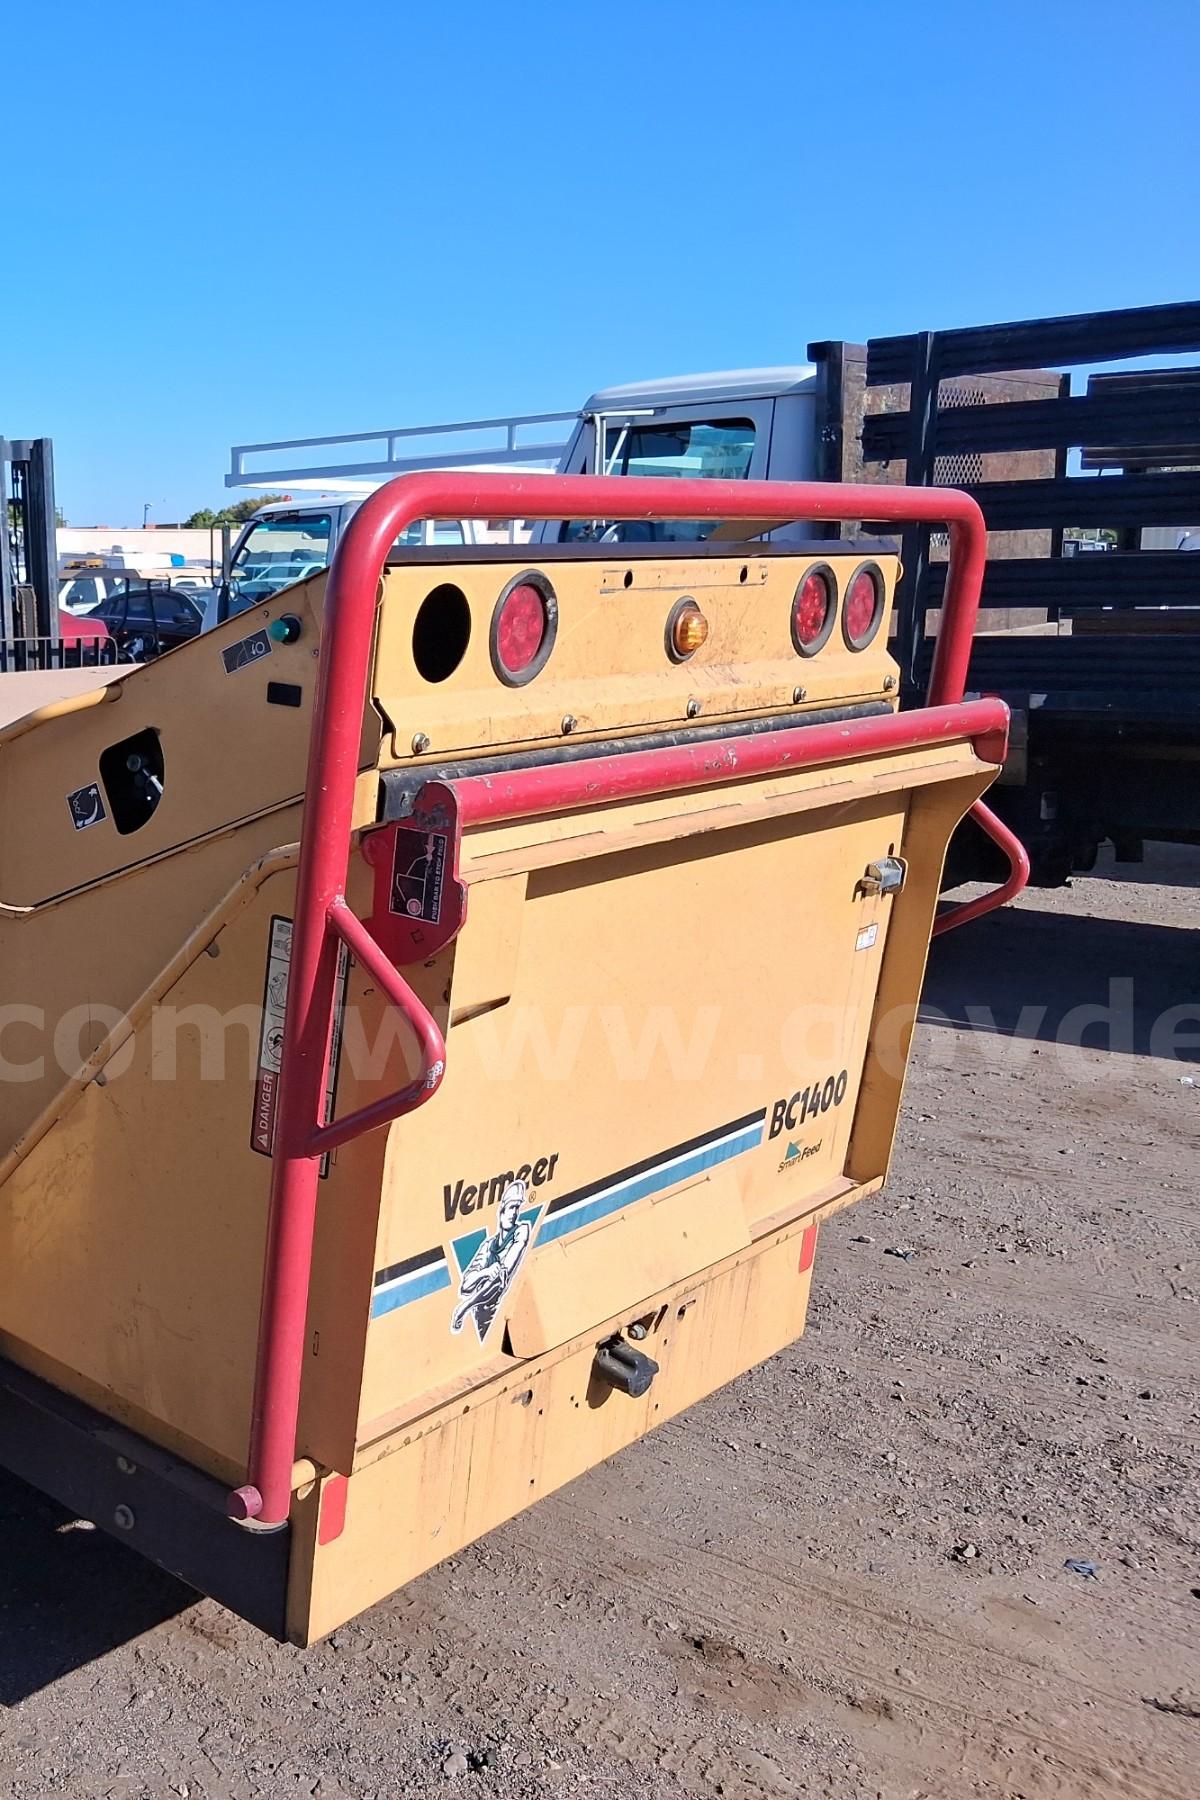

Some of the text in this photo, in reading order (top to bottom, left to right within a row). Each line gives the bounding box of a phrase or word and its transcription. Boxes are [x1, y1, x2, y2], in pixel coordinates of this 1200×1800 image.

[434, 876, 441, 885] TO
[259, 1074, 273, 1129] DANGER
[768, 1069, 848, 1141] BC1400
[443, 1152, 560, 1222] Vermeer
